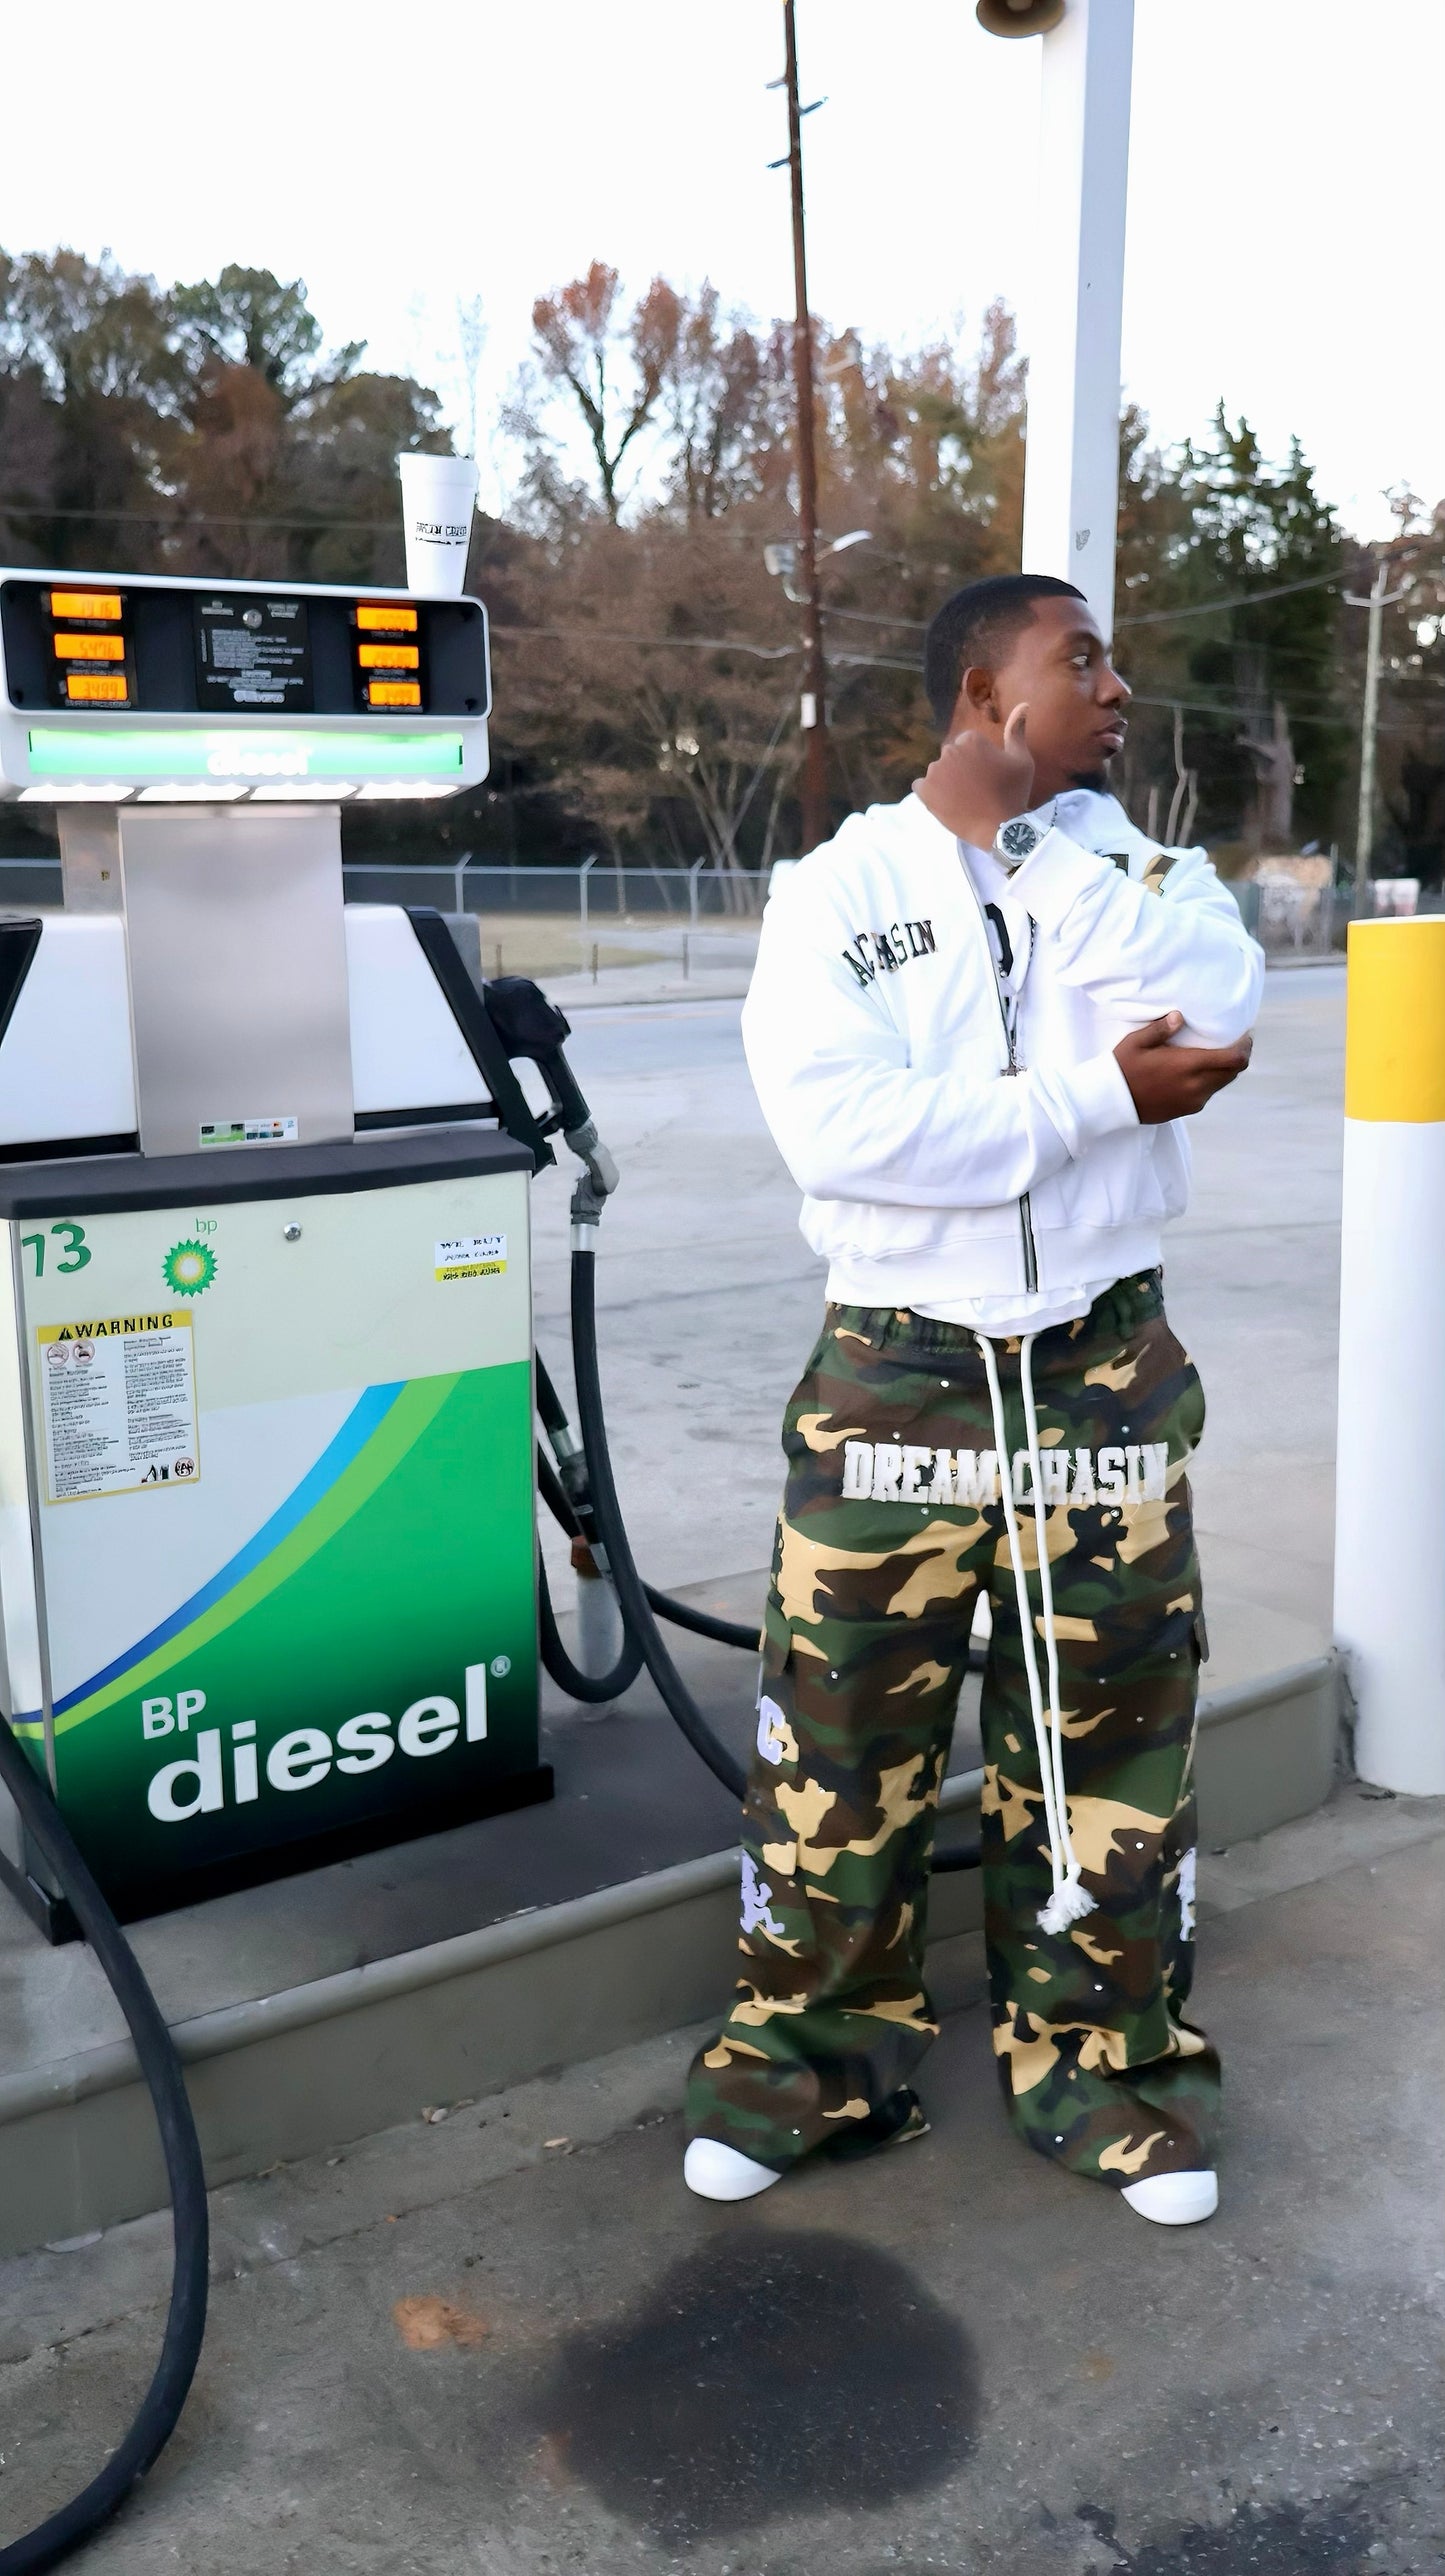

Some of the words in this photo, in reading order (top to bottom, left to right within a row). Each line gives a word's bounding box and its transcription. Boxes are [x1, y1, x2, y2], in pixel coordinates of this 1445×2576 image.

[195, 1218, 218, 1235] bp
[75, 1314, 174, 1338] WARNING
[840, 1441, 998, 1506] DREAM
[141, 1689, 207, 1740] BP
[147, 1662, 488, 1823] diesel
